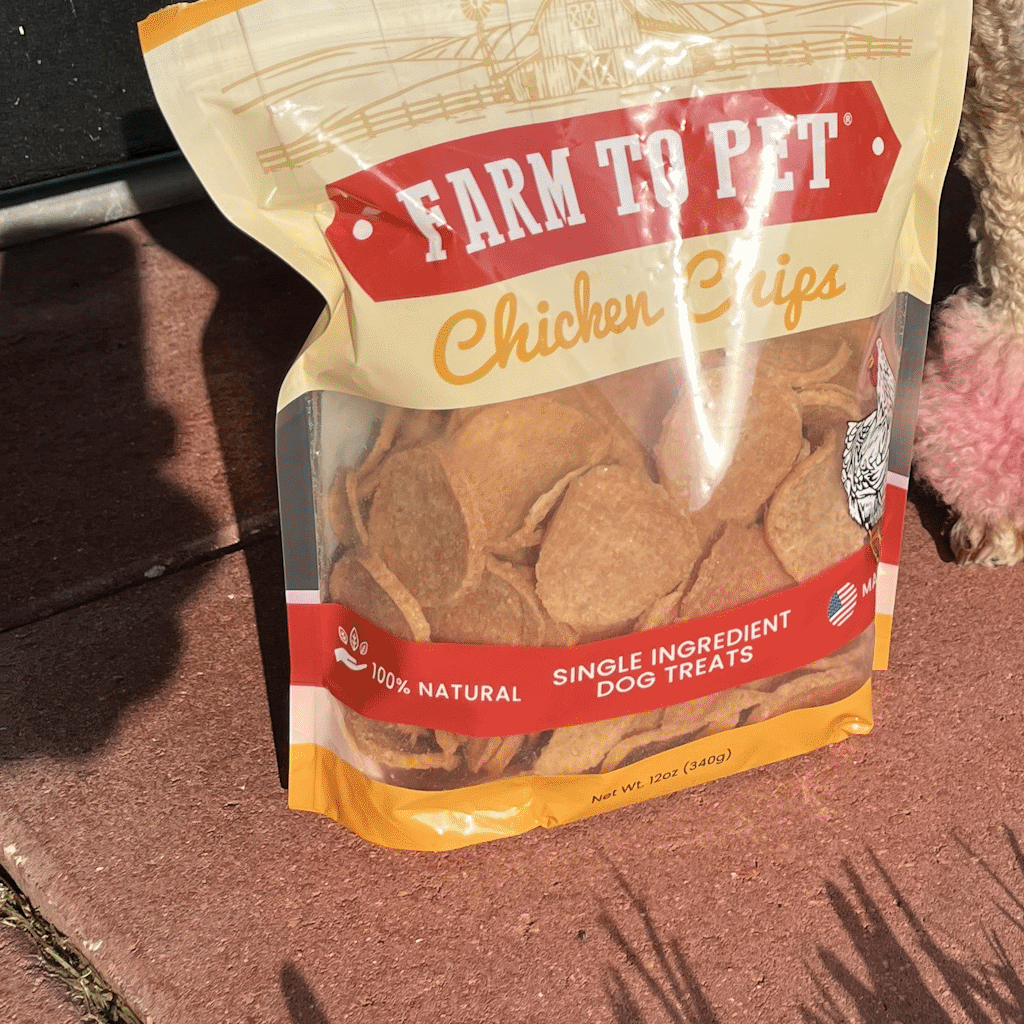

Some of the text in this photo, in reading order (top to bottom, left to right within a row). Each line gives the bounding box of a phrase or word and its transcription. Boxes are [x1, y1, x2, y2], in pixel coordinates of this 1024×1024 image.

[395, 147, 587, 263] FARM
[594, 129, 689, 216] TO
[433, 270, 665, 385] Chicken
[552, 609, 792, 686] SINGLE INGREDIENT
[597, 645, 754, 698] DOG TREATS
[372, 662, 522, 702] 100% NATURAL
[591, 789, 617, 804] Net
[649, 769, 678, 784] 12oz
[683, 748, 732, 774] (340g)
